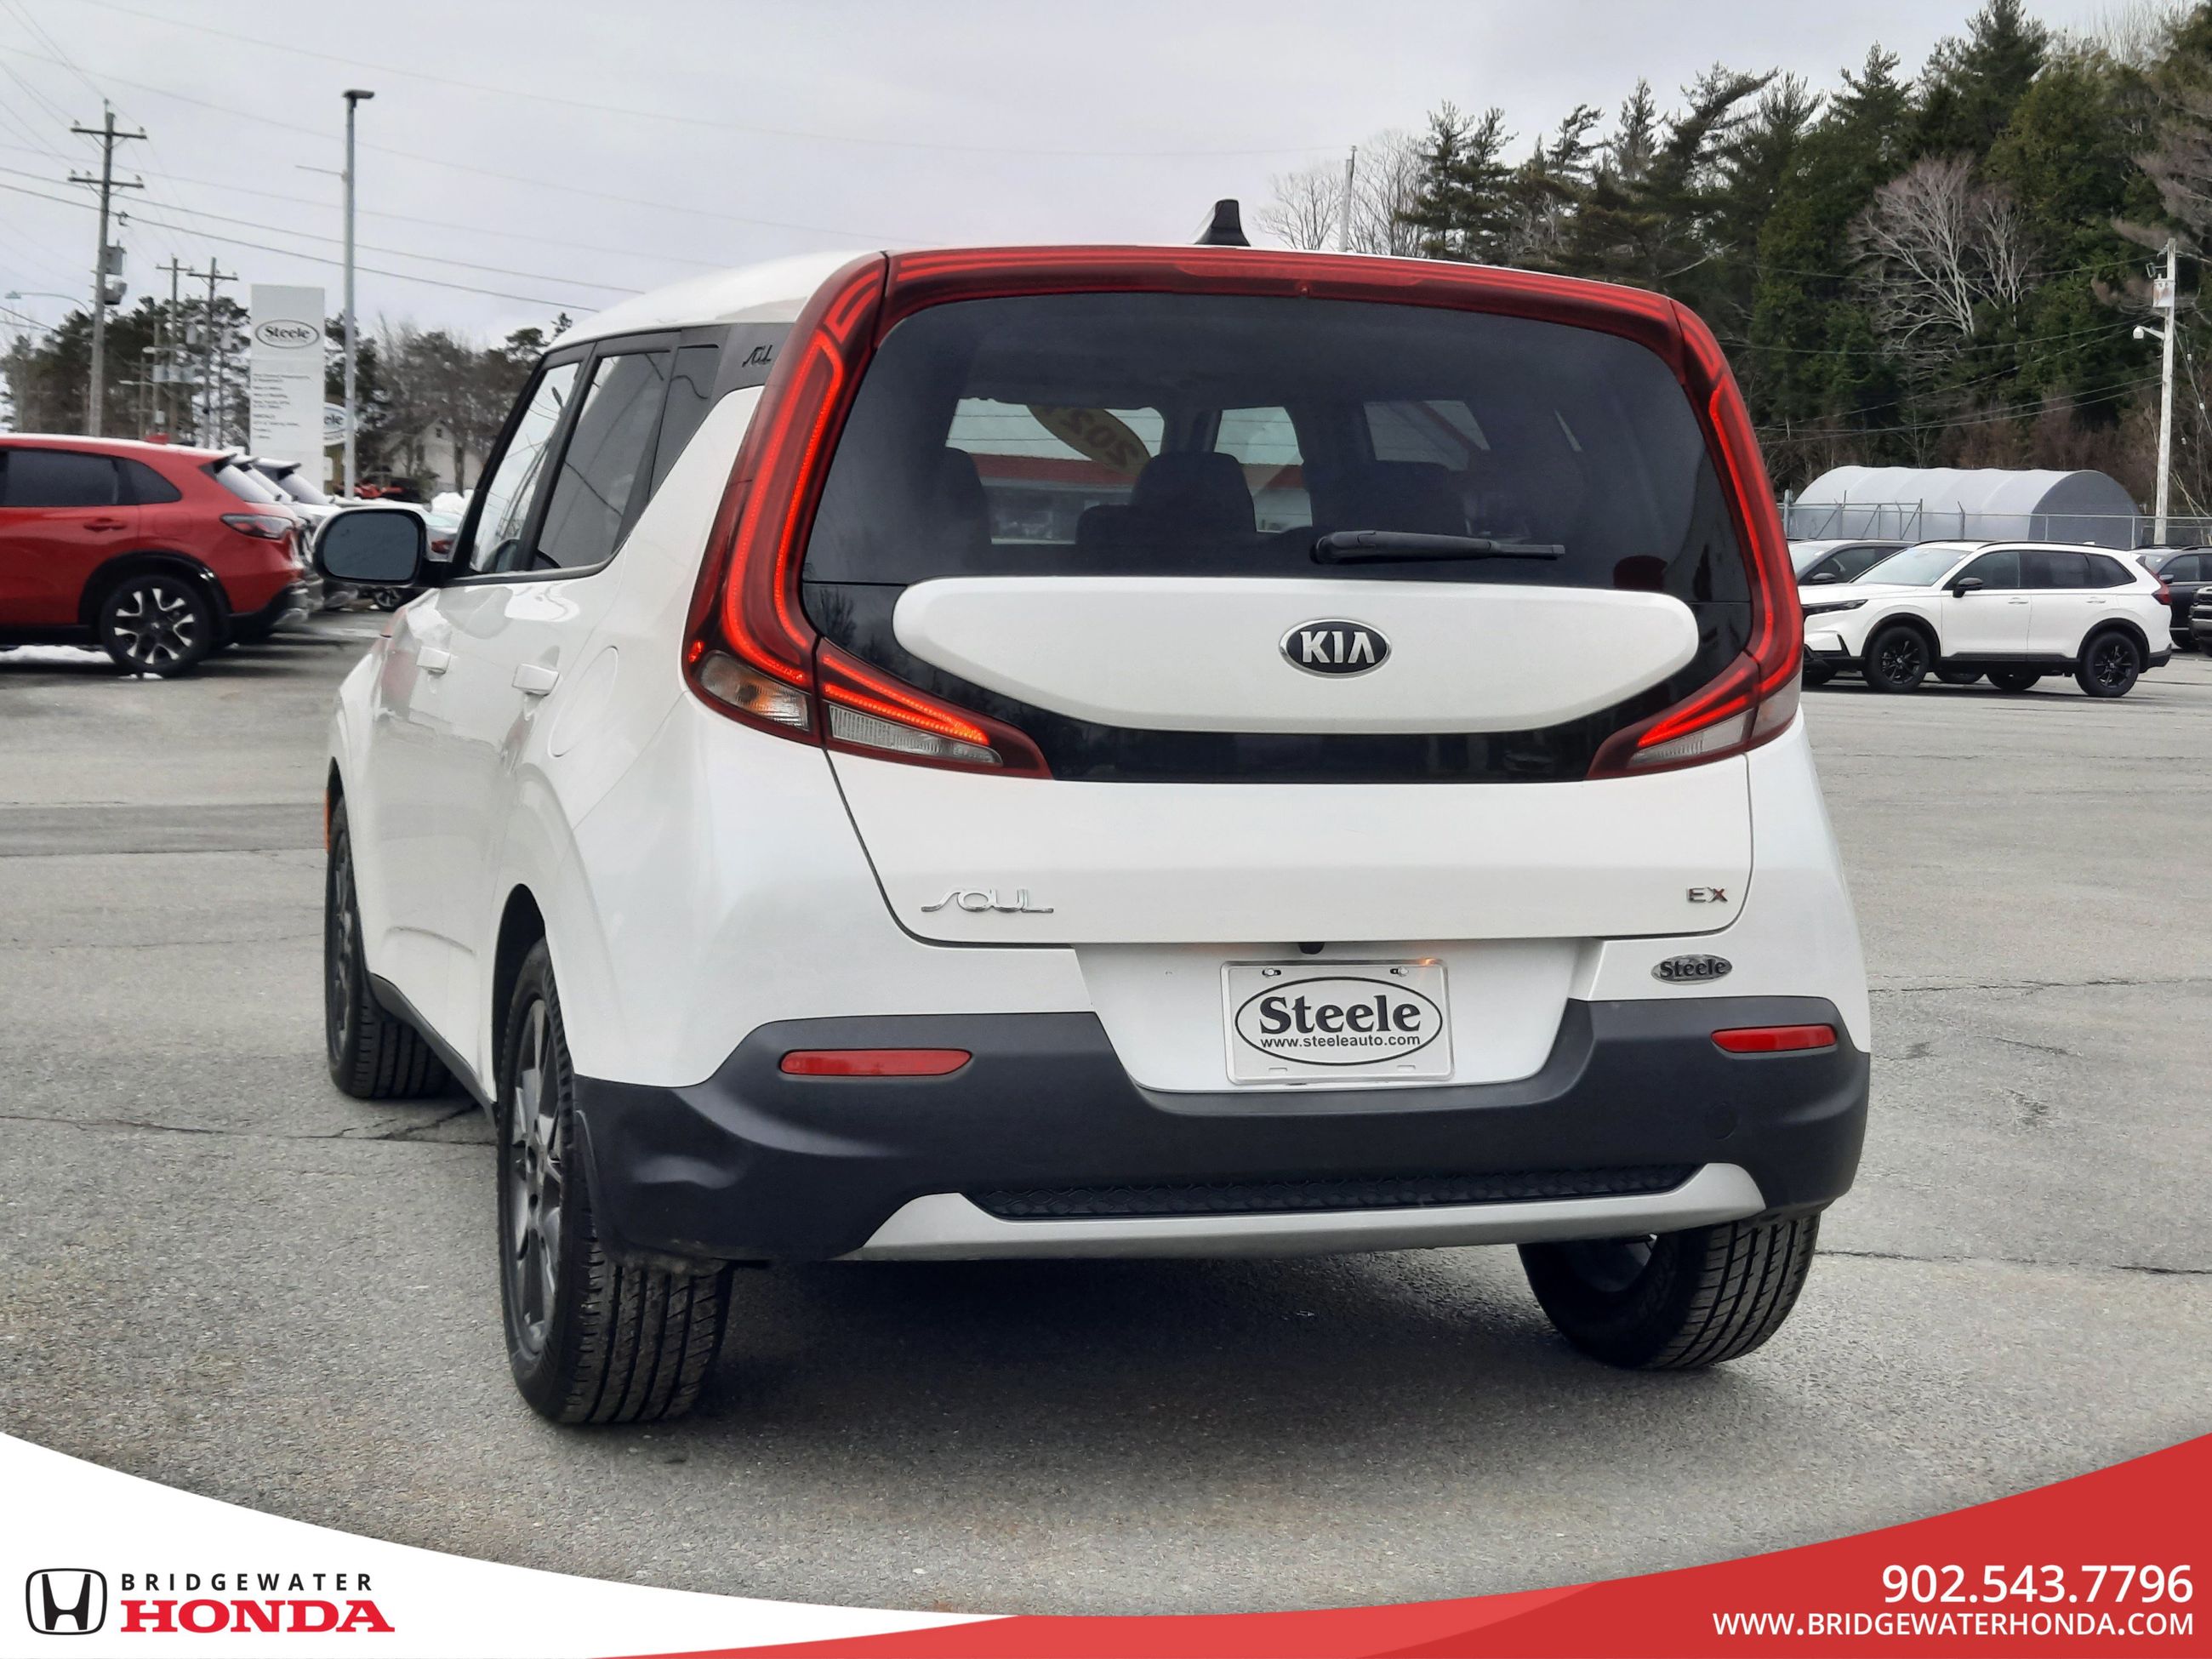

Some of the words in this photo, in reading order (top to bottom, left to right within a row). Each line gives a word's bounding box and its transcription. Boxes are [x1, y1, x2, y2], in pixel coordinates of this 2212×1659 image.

[265, 326, 310, 339] Steele
[1300, 631, 1376, 664] KIA
[921, 887, 1054, 913] SOUL
[1687, 887, 1728, 903] EX
[1660, 959, 1725, 978] Steele
[1259, 995, 1421, 1034] Steele
[1261, 1034, 1421, 1048] www.steeleauto.com
